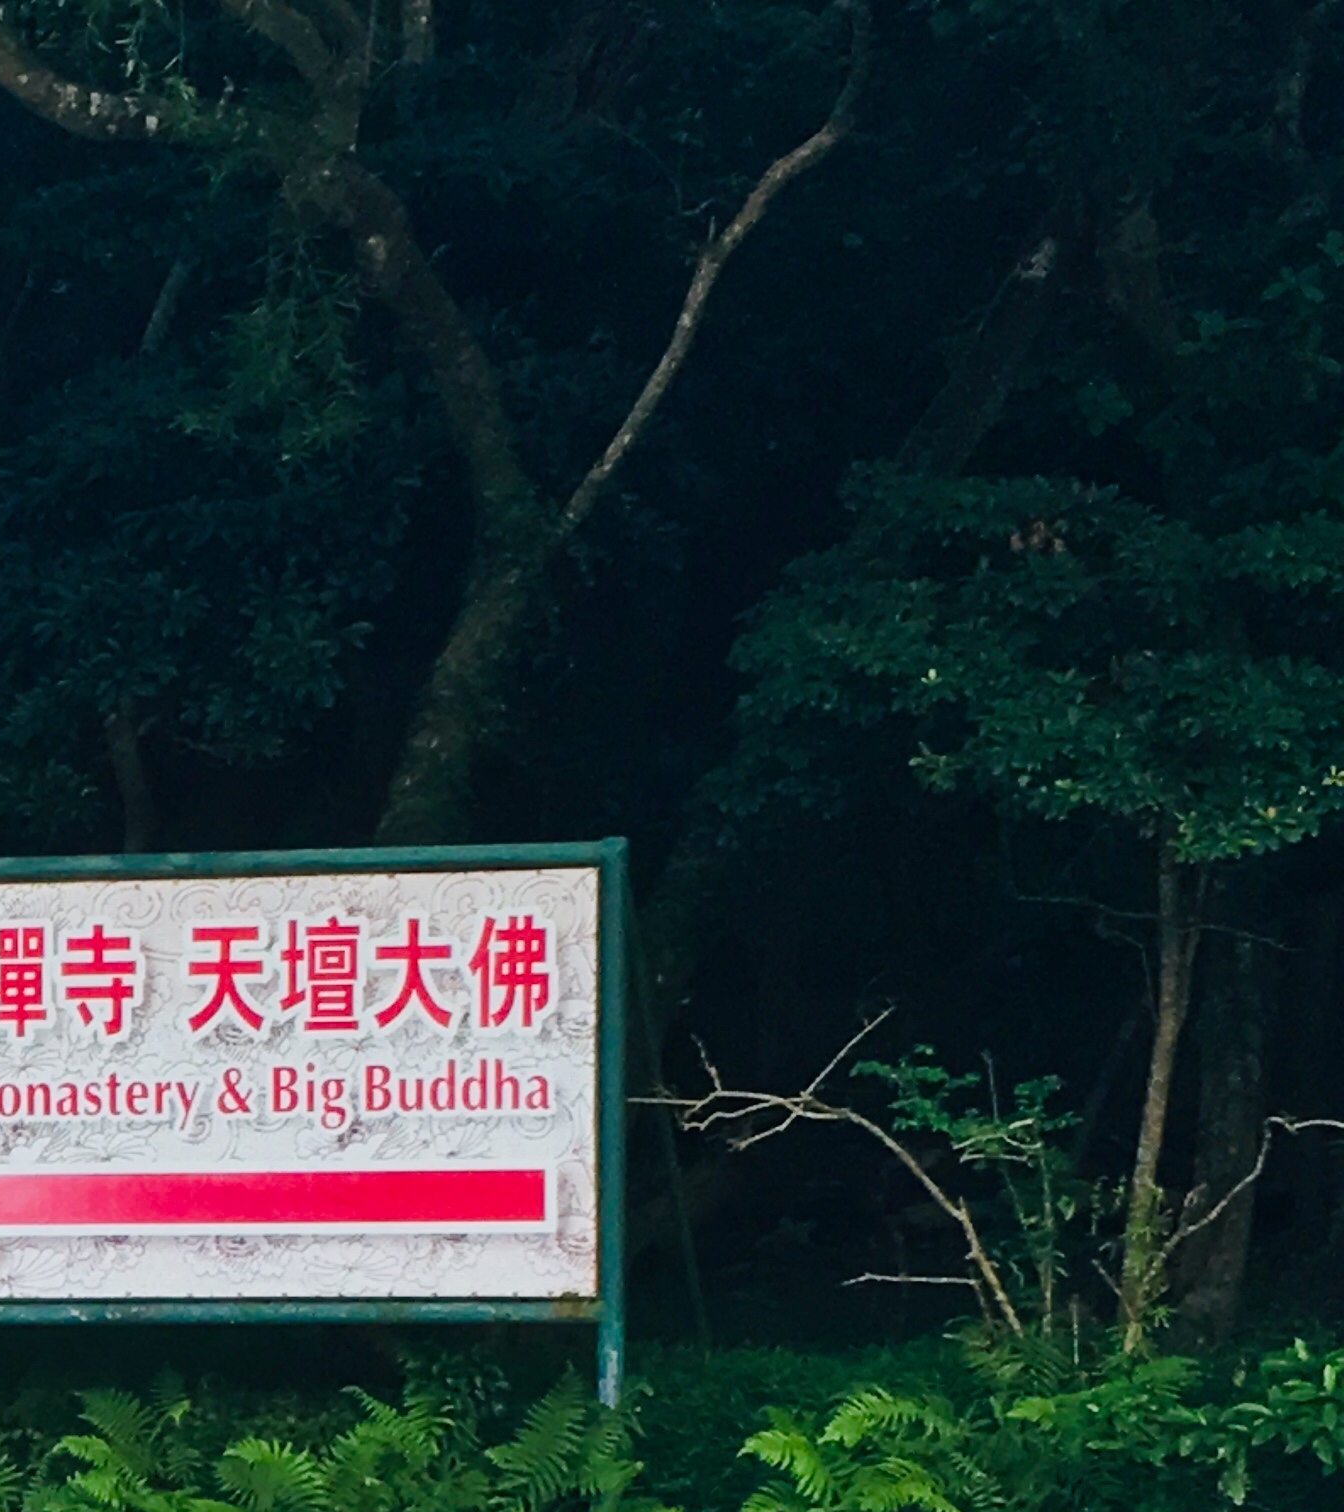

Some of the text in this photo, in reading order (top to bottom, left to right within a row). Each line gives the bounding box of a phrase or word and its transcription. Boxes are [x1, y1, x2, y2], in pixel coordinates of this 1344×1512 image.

[187, 914, 551, 1031] 天壇大佛
[217, 1070, 253, 1114] &
[272, 1064, 346, 1127] Big
[365, 1059, 550, 1111] Buddha
